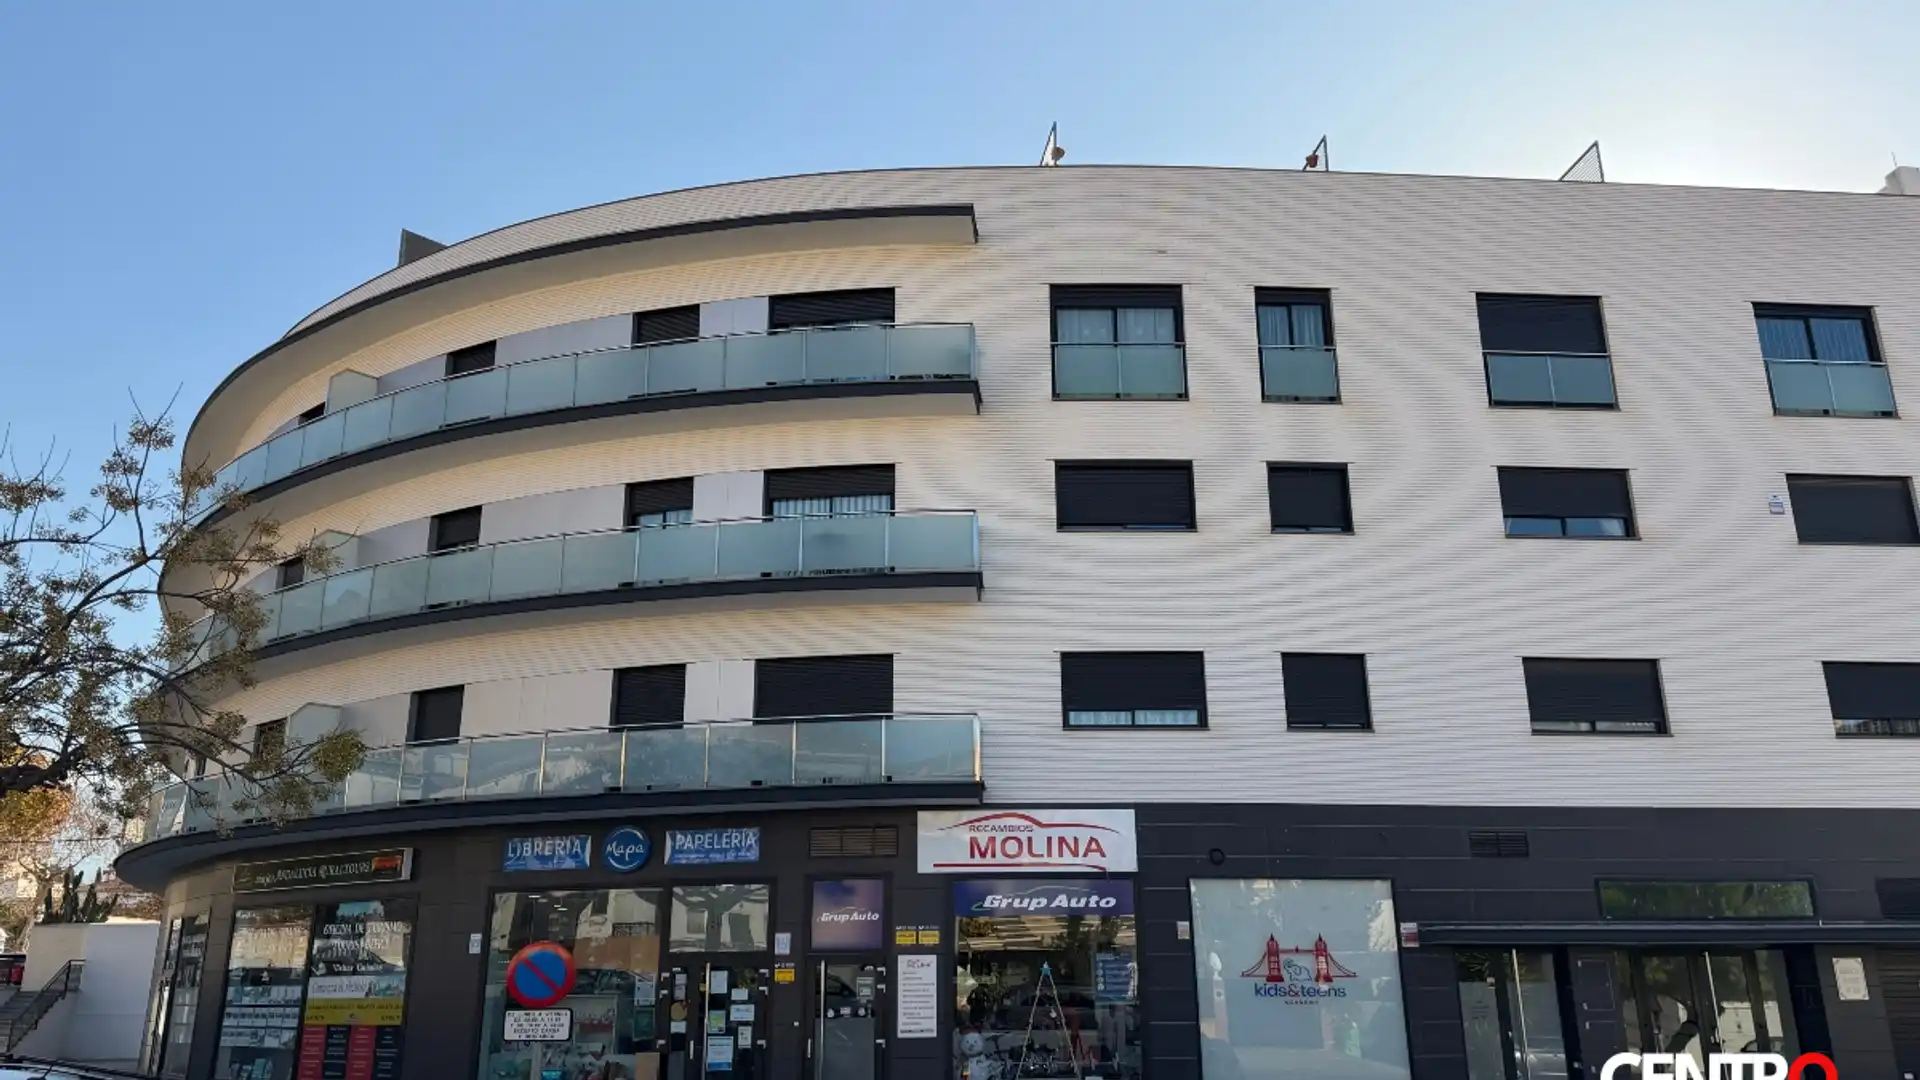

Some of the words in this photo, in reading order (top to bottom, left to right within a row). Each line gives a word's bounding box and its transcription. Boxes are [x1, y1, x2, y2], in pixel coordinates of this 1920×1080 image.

[968, 823, 1035, 833] RECAMBIOS
[604, 841, 645, 862] Mapa
[968, 835, 1108, 860] MOLINA
[983, 894, 1048, 910] Grup
[1050, 893, 1117, 908] Auto
[820, 912, 850, 923] Grup
[850, 911, 880, 921] Auto
[1253, 983, 1347, 998] kids&teens
